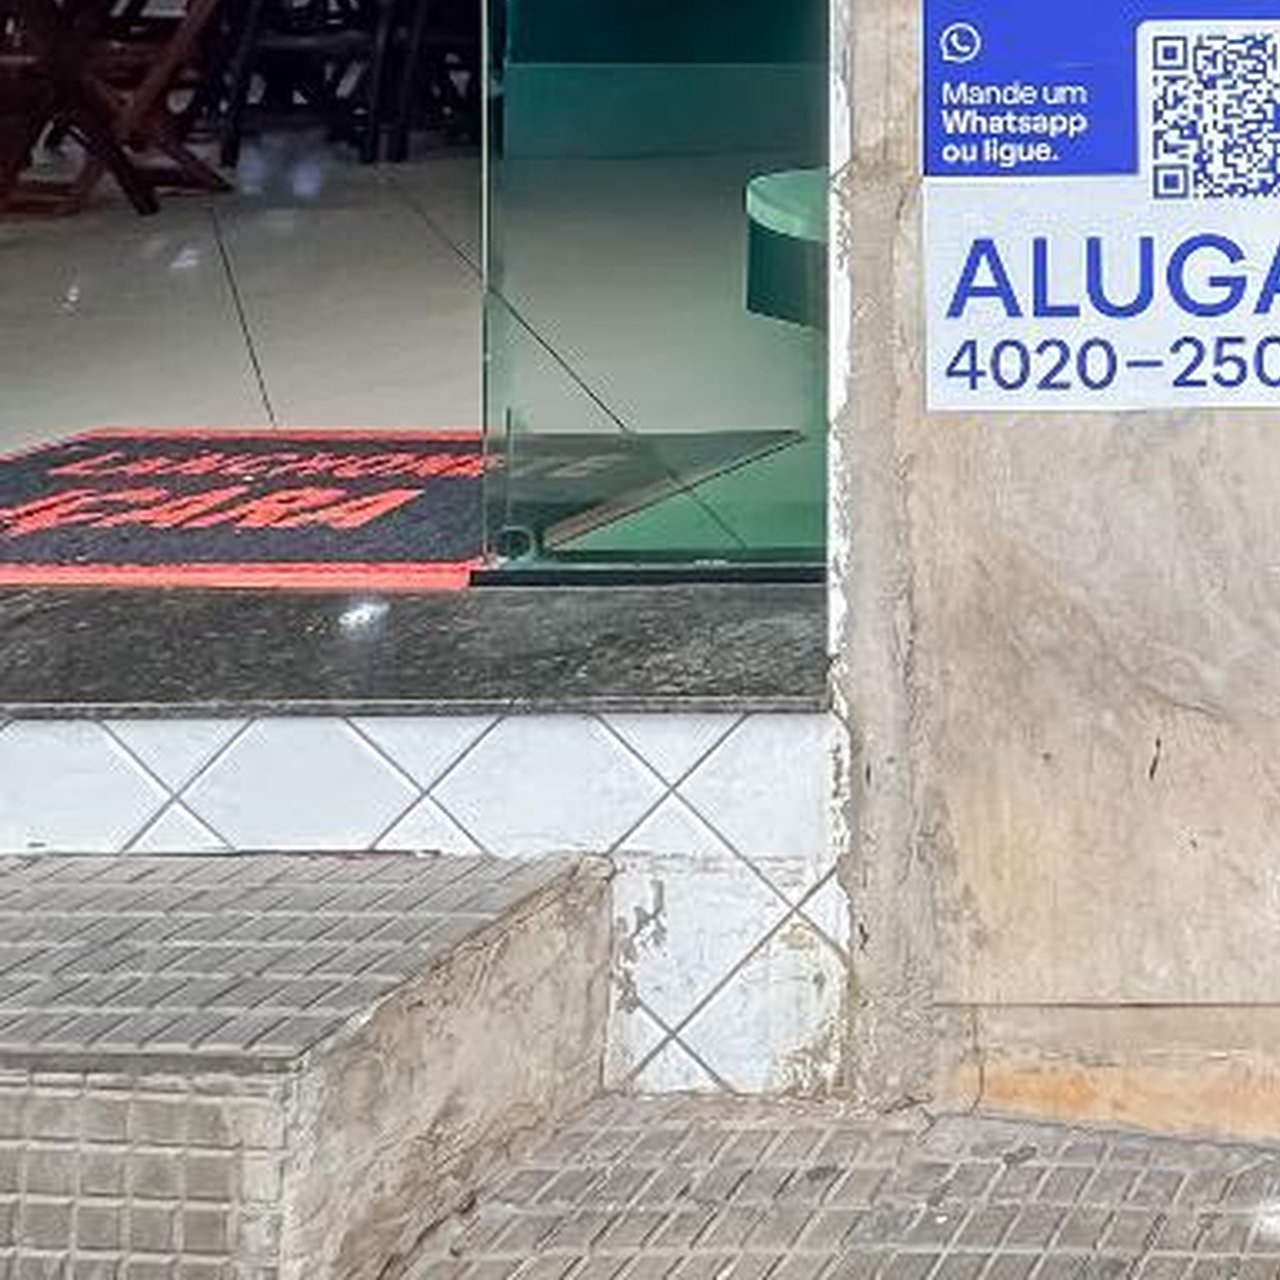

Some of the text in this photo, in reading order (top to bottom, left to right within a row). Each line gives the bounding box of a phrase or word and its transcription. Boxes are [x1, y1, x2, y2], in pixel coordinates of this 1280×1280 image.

[942, 81, 1088, 105] Mande um
[941, 109, 1089, 138] Whatsapp
[941, 137, 1060, 168] ou ligue.
